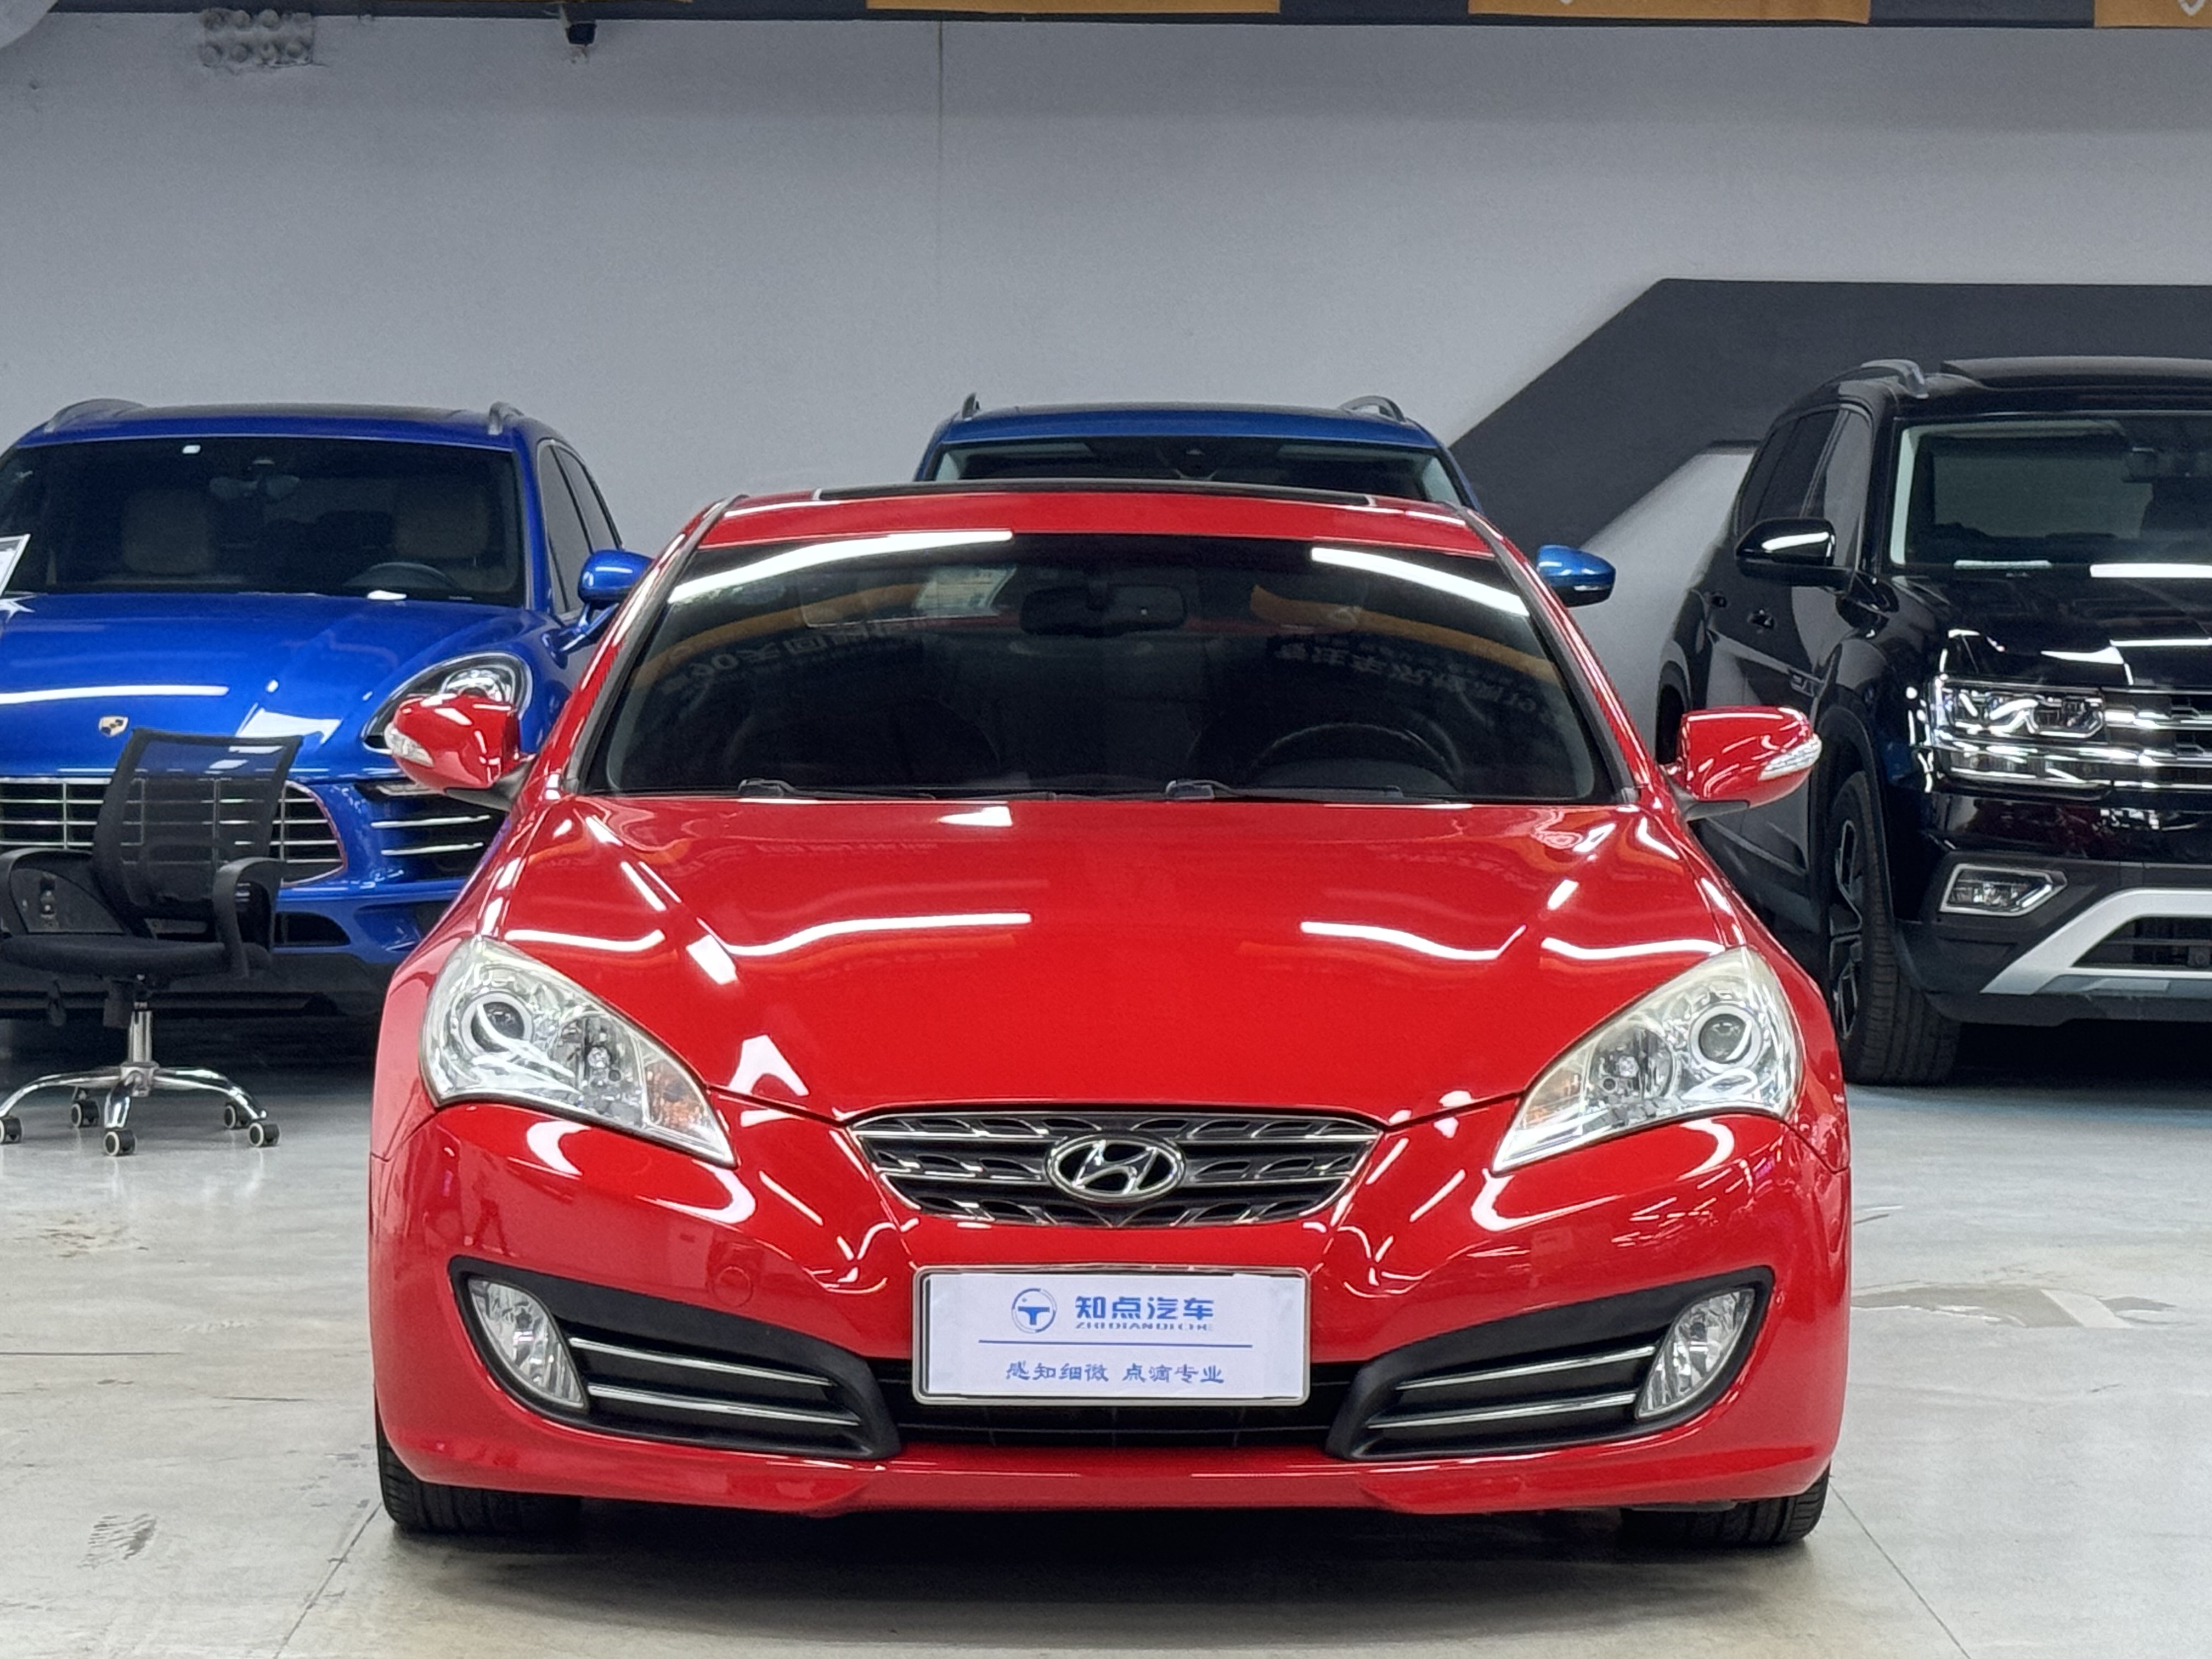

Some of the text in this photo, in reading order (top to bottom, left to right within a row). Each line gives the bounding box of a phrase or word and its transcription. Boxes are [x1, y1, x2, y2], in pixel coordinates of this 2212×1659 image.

[1075, 1296, 1215, 1321] 知点汽车
[1006, 1361, 1225, 1384] 感知细微 点滴专业
